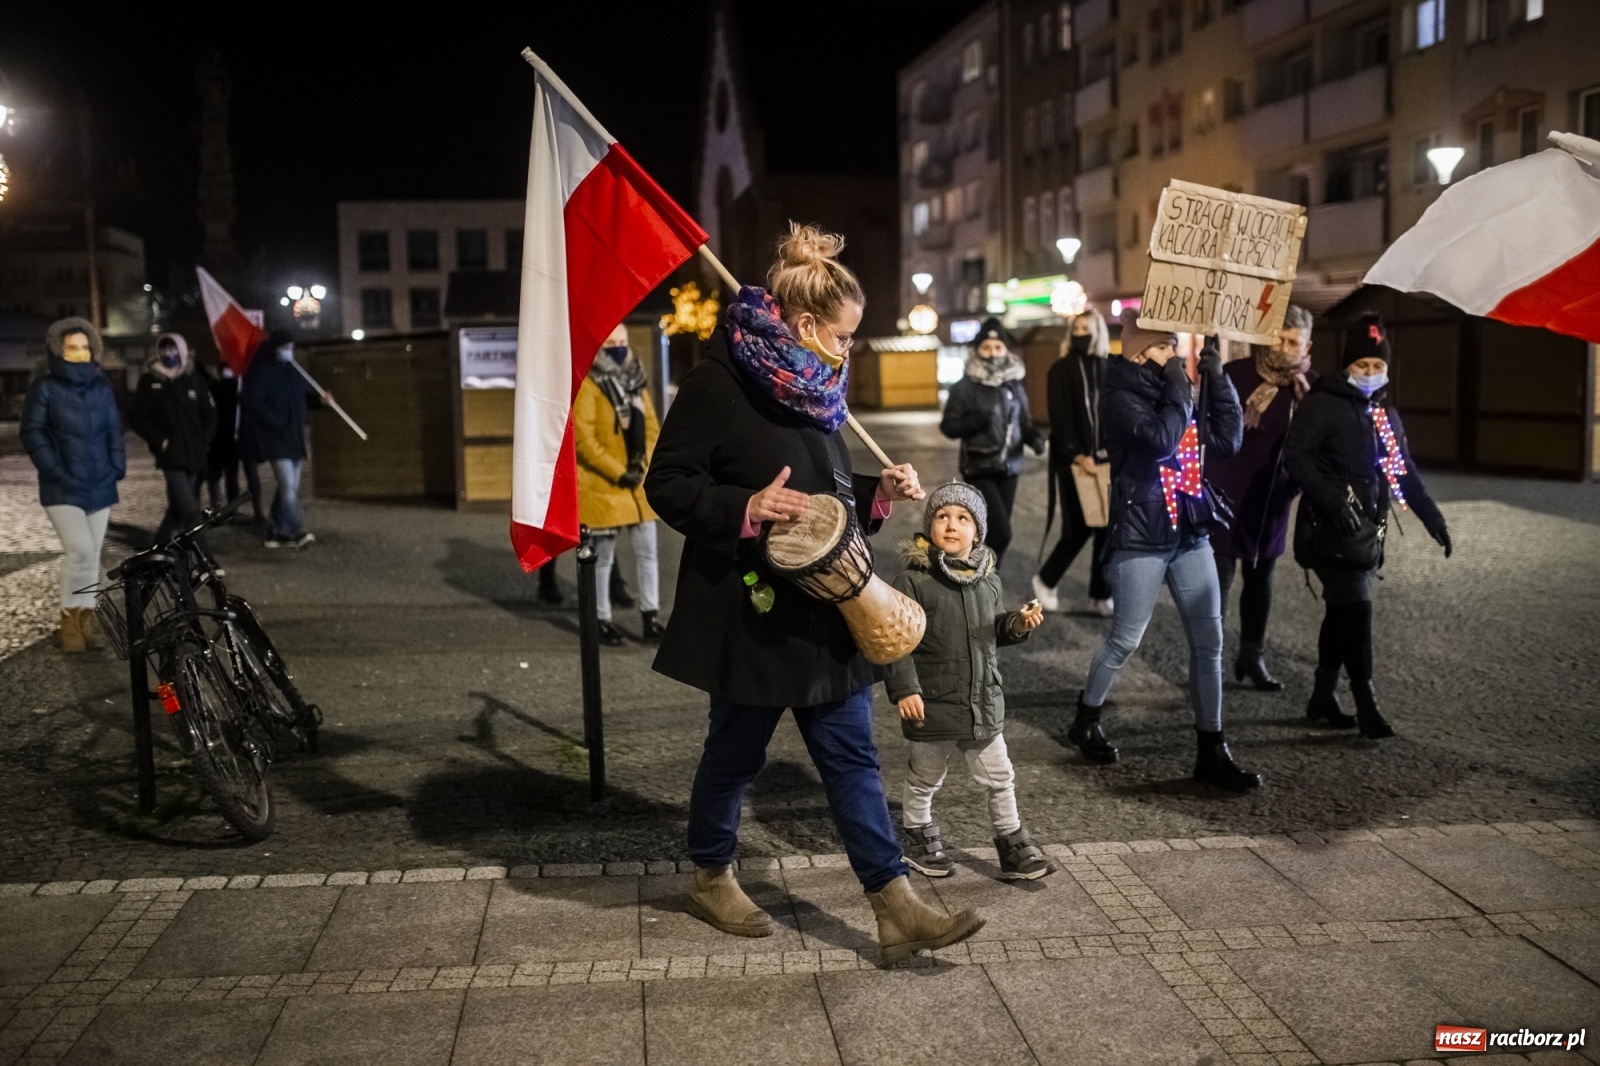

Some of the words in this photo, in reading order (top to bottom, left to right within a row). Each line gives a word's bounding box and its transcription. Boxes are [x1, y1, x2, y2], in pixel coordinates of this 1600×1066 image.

[1170, 196, 1234, 231] STRACH
[1237, 210, 1251, 236] W
[1158, 222, 1219, 259] KACZORA
[1230, 237, 1284, 269] LEPSZY
[1205, 270, 1228, 291] OD
[1142, 284, 1251, 331] WIBRATORA
[466, 350, 517, 363] PARTNE
